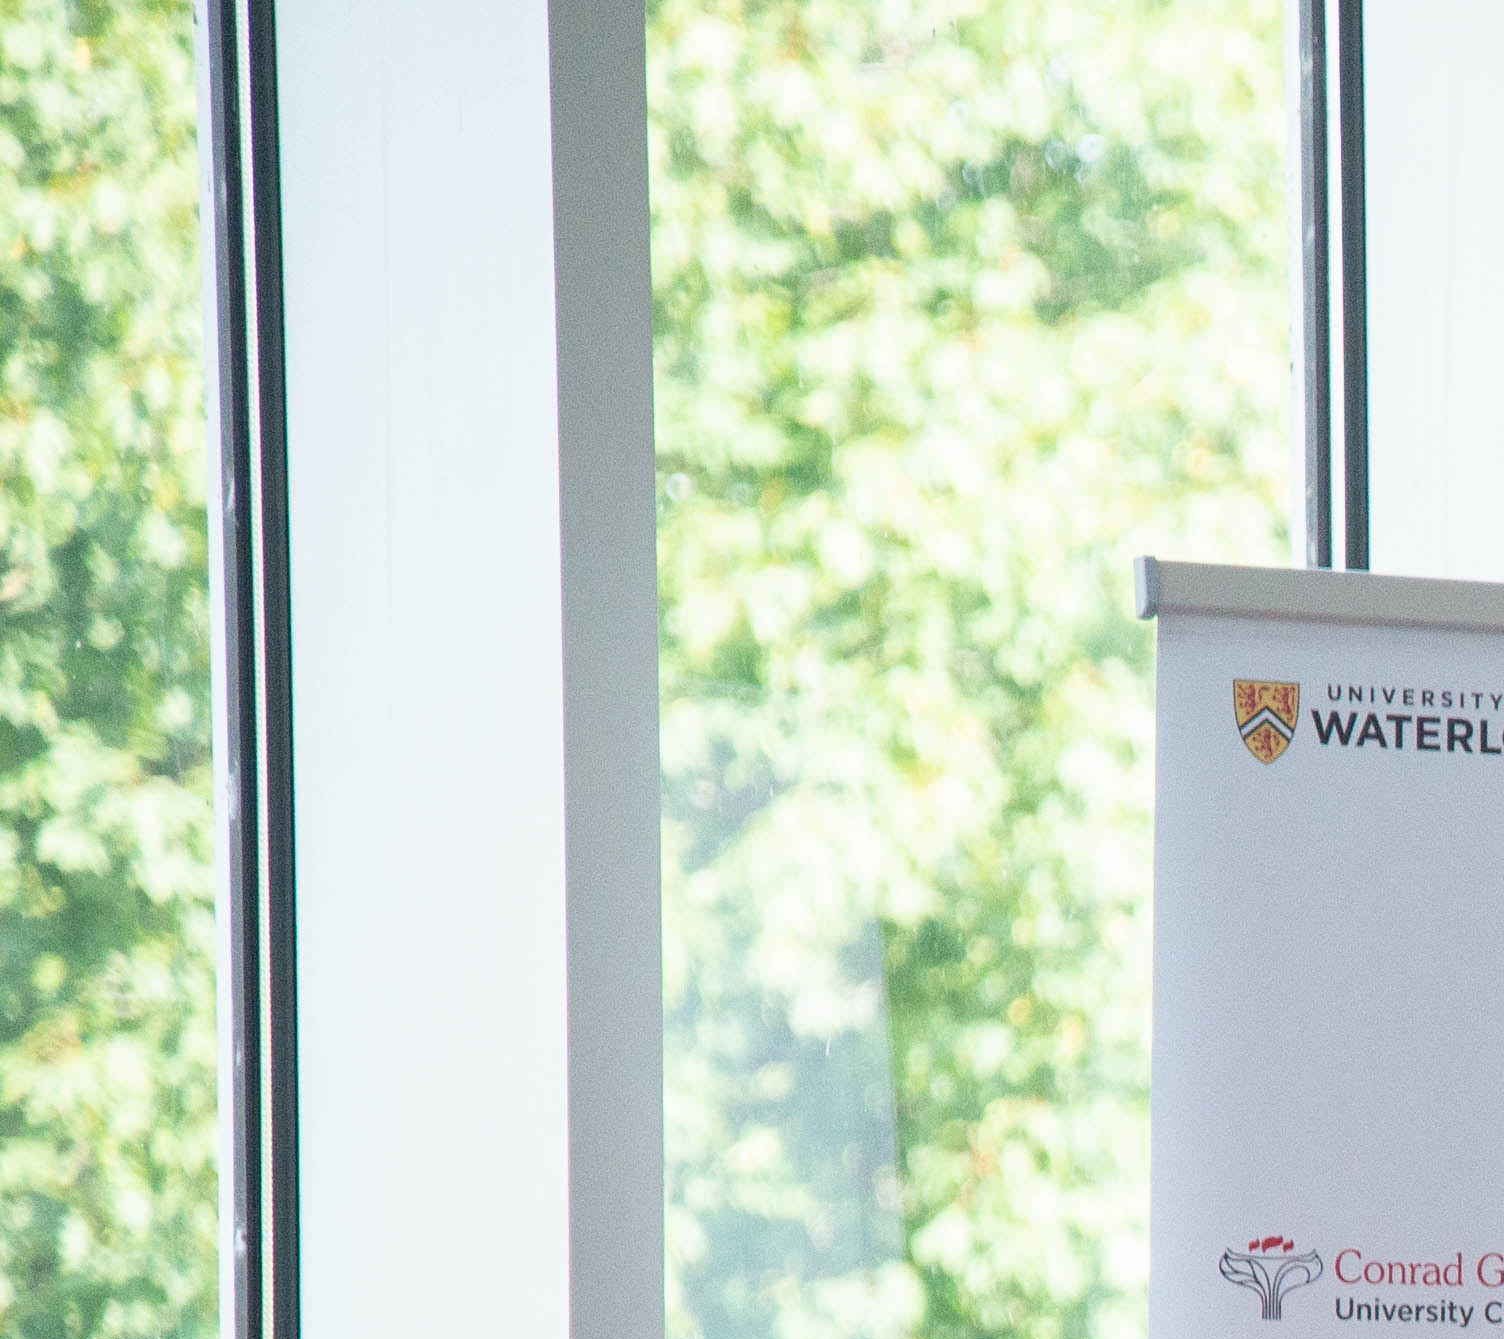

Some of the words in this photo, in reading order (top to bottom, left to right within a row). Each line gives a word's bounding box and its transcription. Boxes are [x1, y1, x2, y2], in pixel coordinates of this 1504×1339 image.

[1327, 683, 1504, 711] UNIVERSITY
[1334, 1248, 1464, 1287] Conrad
[1335, 1297, 1475, 1328] University
